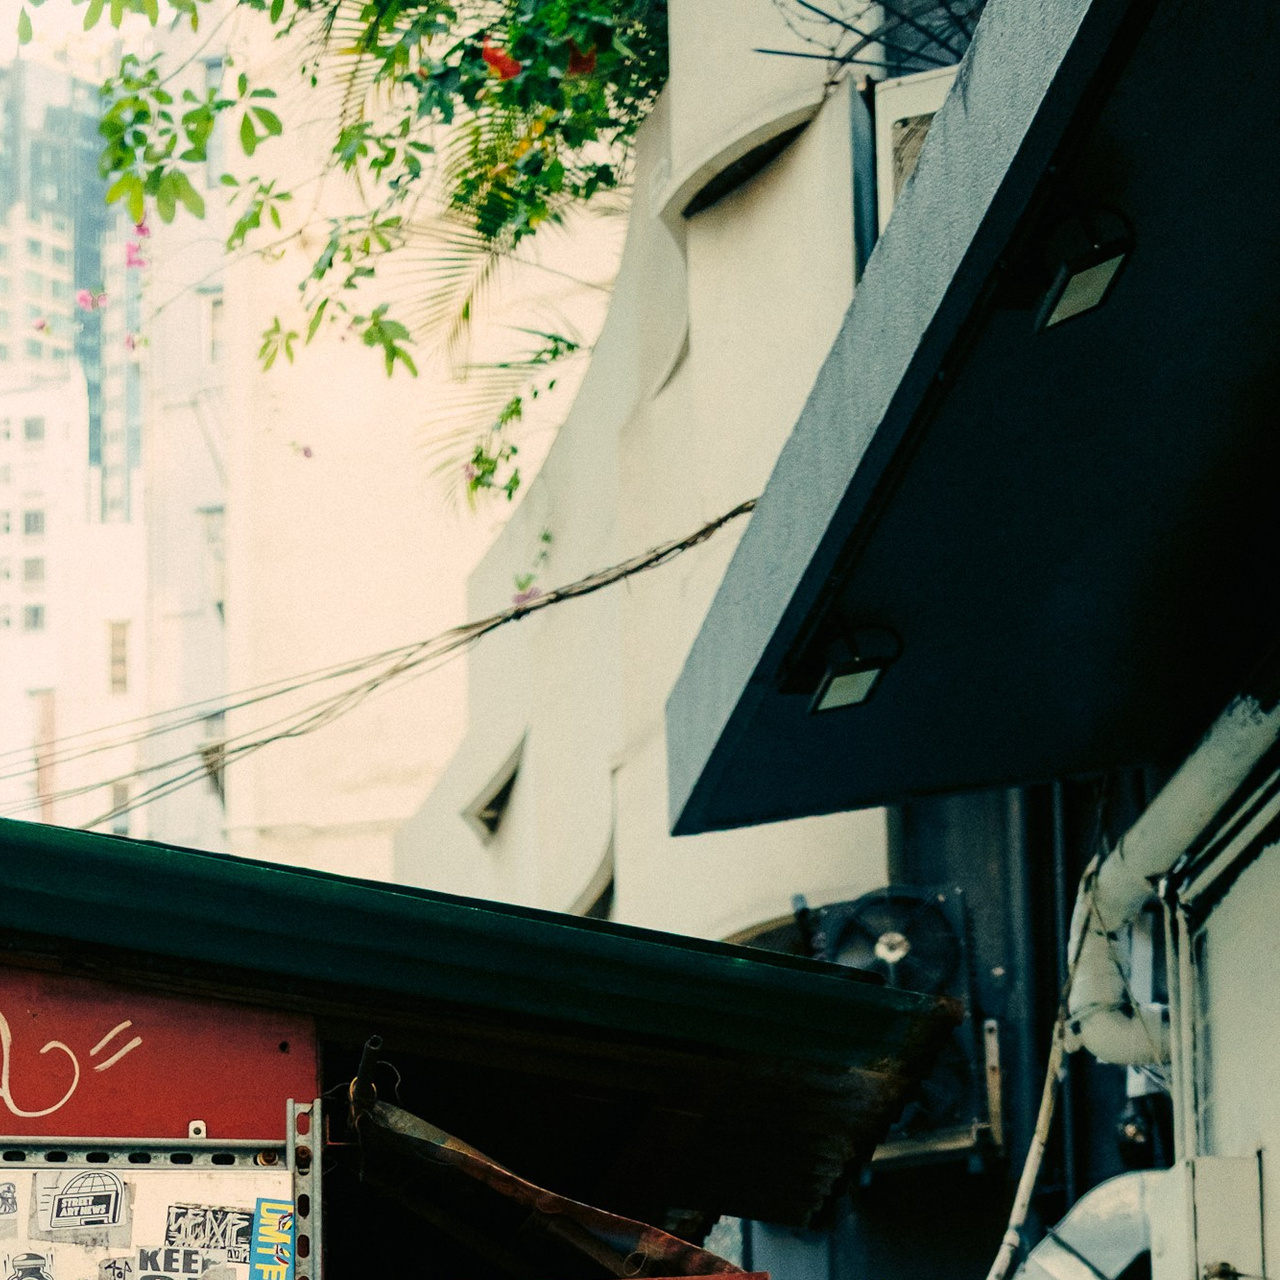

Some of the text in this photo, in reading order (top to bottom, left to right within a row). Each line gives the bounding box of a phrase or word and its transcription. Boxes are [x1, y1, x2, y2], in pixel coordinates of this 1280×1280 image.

[61, 1197, 94, 1206] STREET
[60, 1205, 107, 1217] ART NEWS
[139, 1249, 206, 1273] KEE
